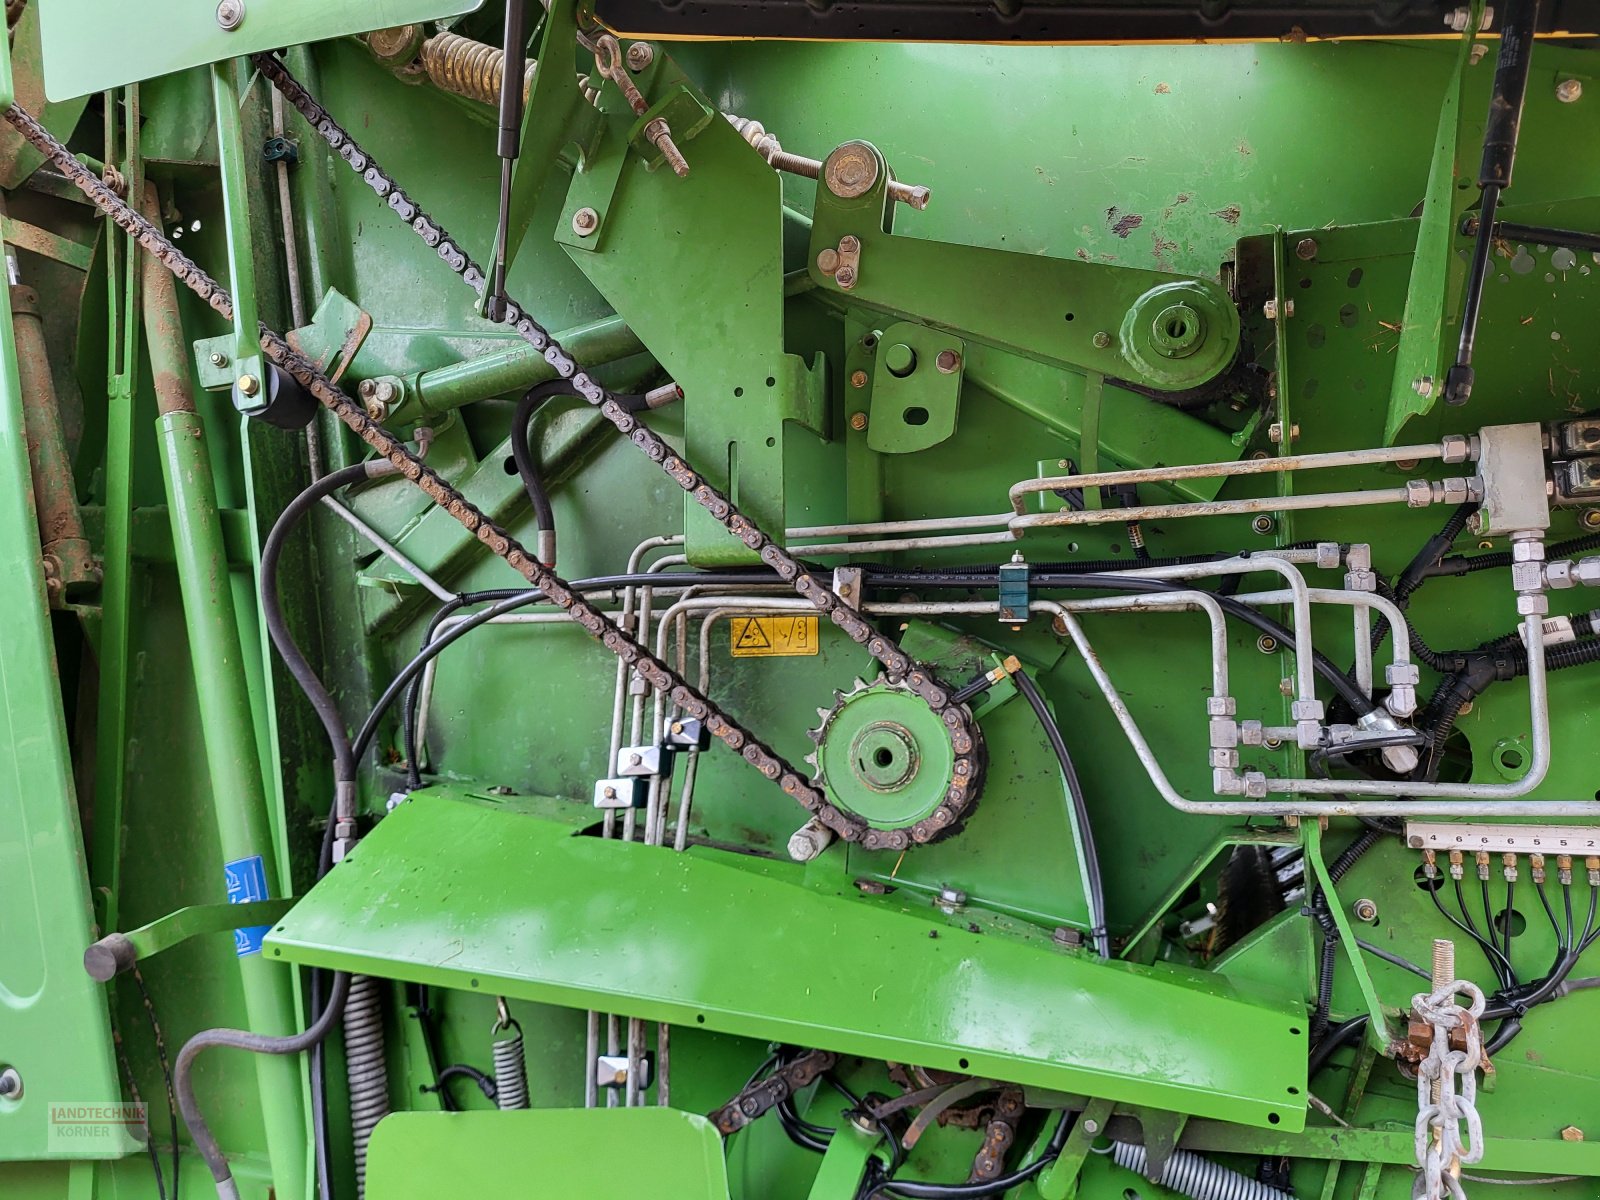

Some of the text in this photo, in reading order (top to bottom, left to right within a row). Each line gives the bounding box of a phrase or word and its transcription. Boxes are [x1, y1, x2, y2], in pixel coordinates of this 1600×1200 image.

[1455, 835, 1463, 843] 6
[1481, 836, 1488, 844] 6
[1533, 838, 1541, 846] 5
[1559, 839, 1568, 847] 5
